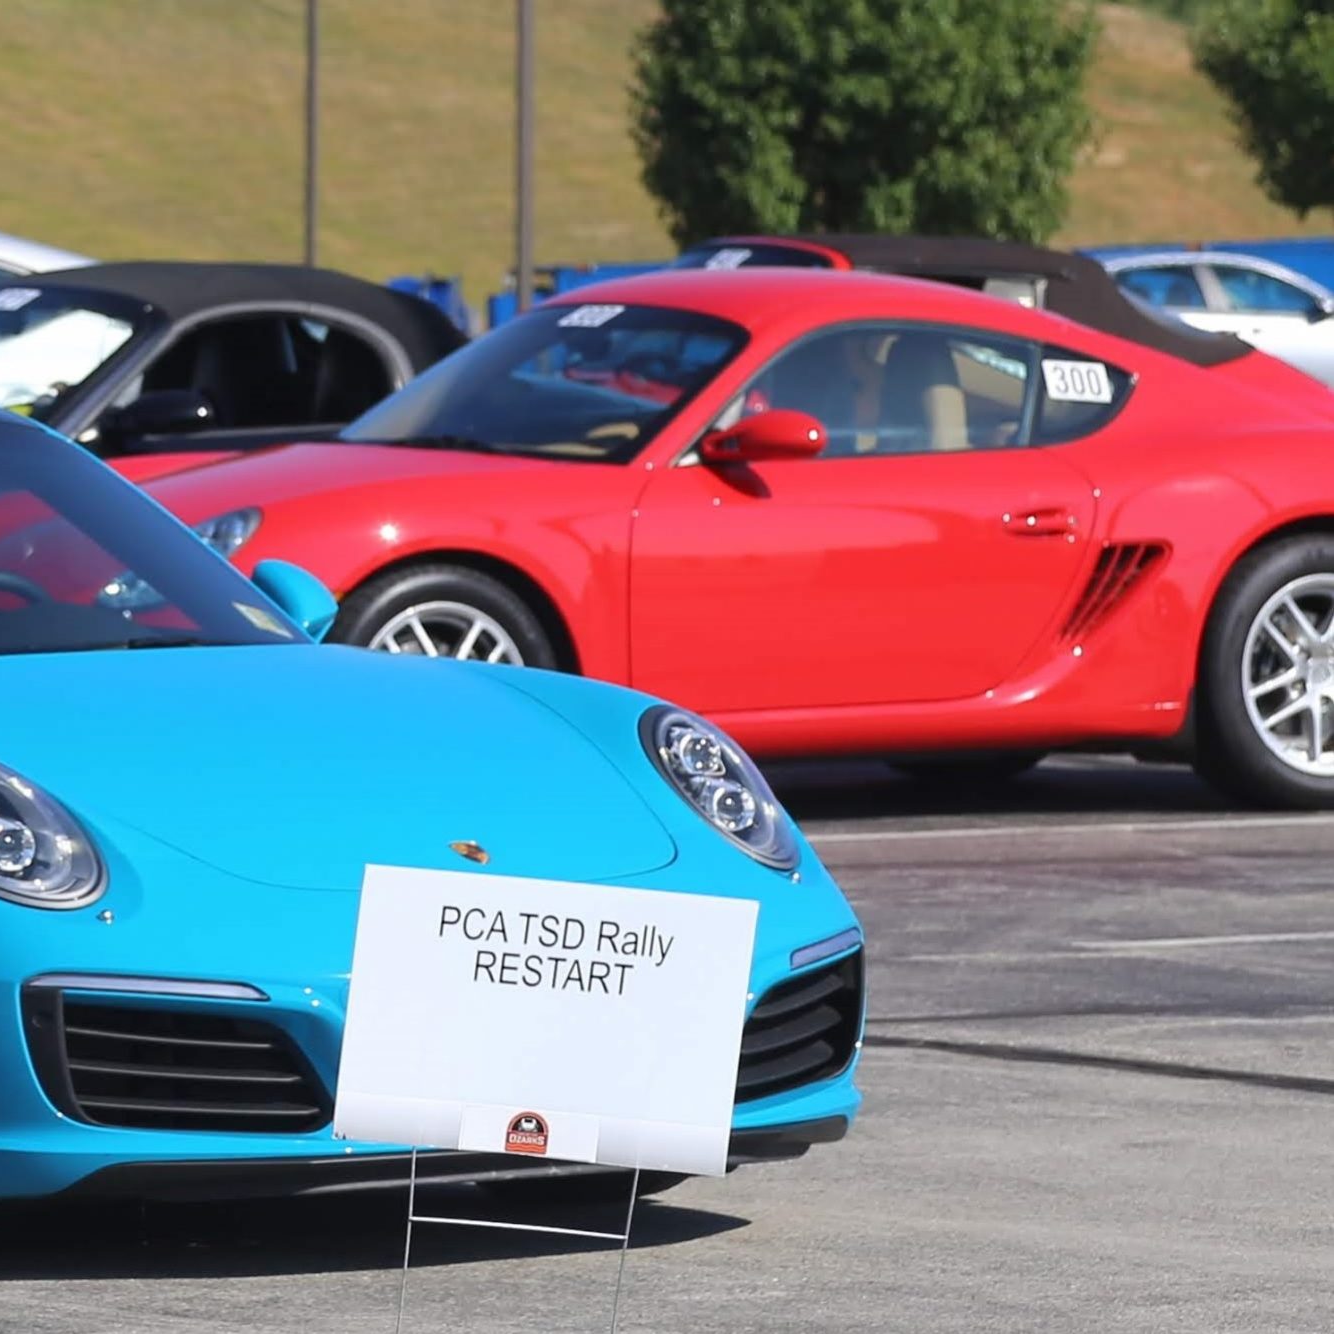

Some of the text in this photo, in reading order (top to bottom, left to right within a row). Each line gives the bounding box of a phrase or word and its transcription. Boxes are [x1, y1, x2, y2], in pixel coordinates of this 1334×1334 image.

[1052, 366, 1102, 396] 300
[438, 905, 674, 967] PCA TSD Rally
[473, 950, 635, 996] RESTART
